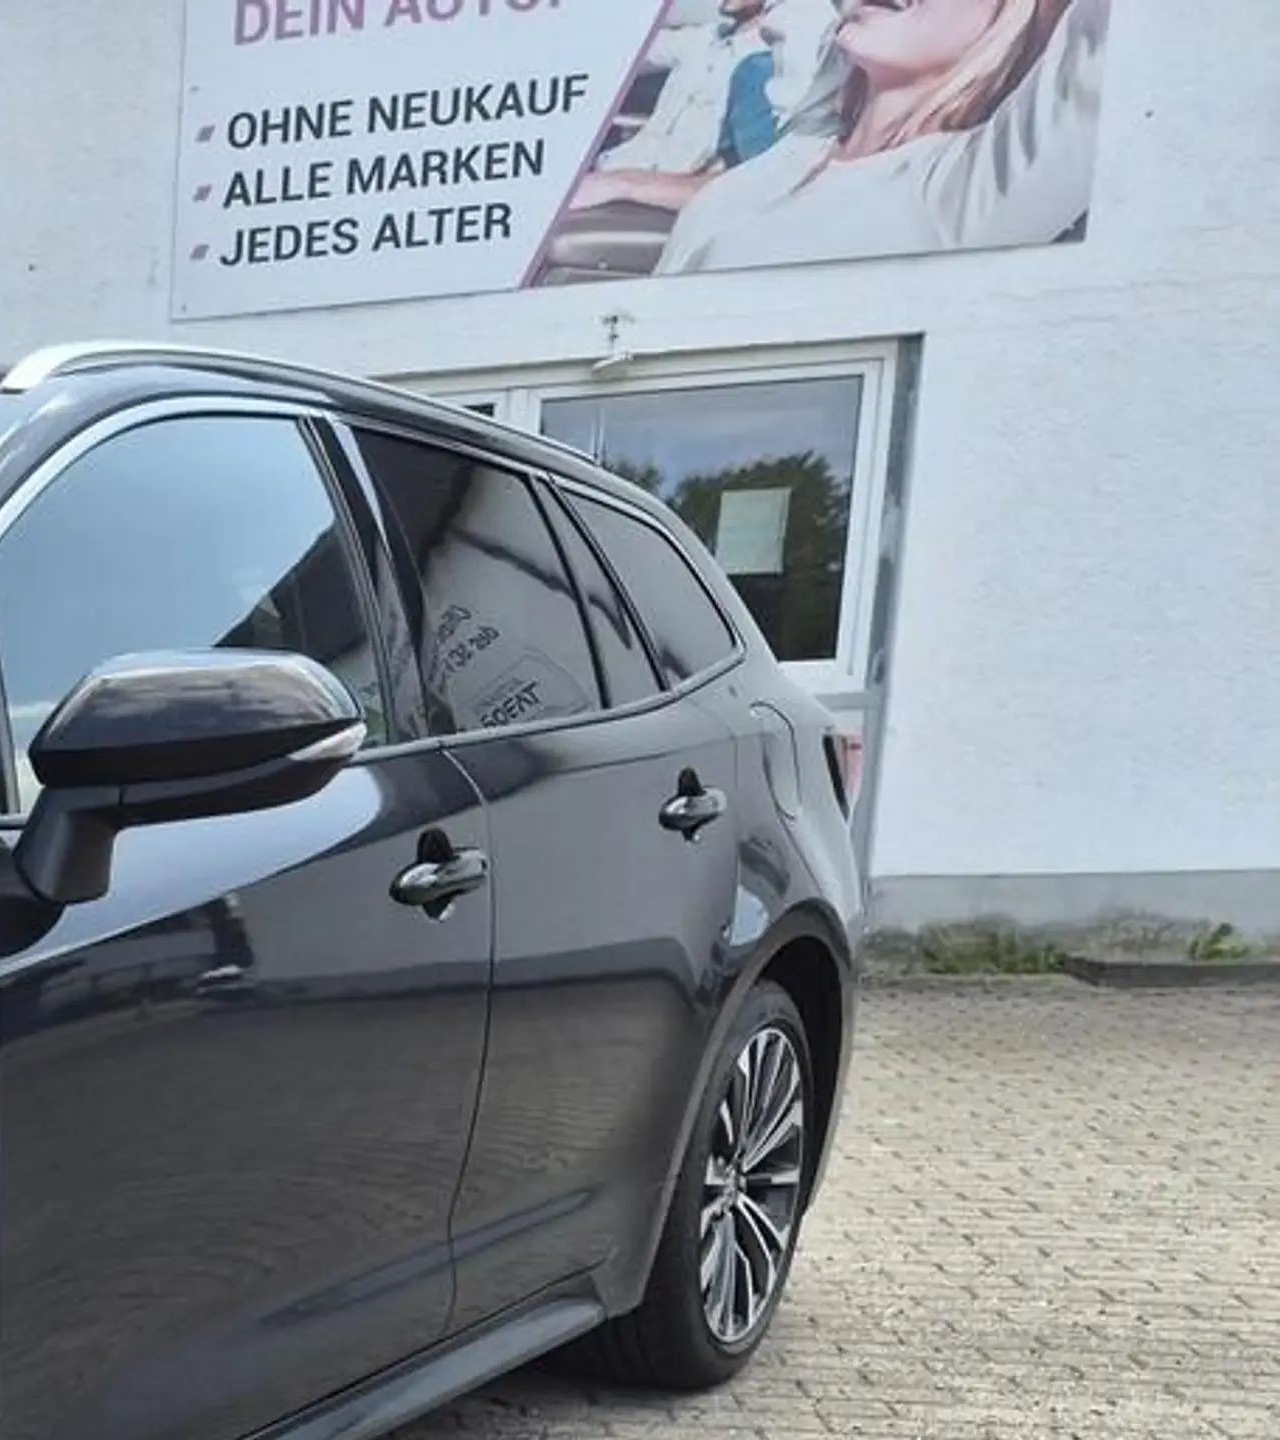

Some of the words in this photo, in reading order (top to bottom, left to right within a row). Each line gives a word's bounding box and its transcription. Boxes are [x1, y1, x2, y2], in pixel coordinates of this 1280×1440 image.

[227, 99, 353, 148] OHNE
[367, 72, 590, 132] NEUKAUF
[222, 161, 334, 209] ALLE
[347, 138, 542, 195] MARKEN
[220, 218, 358, 266] JEDES
[372, 202, 511, 251] ALTER
